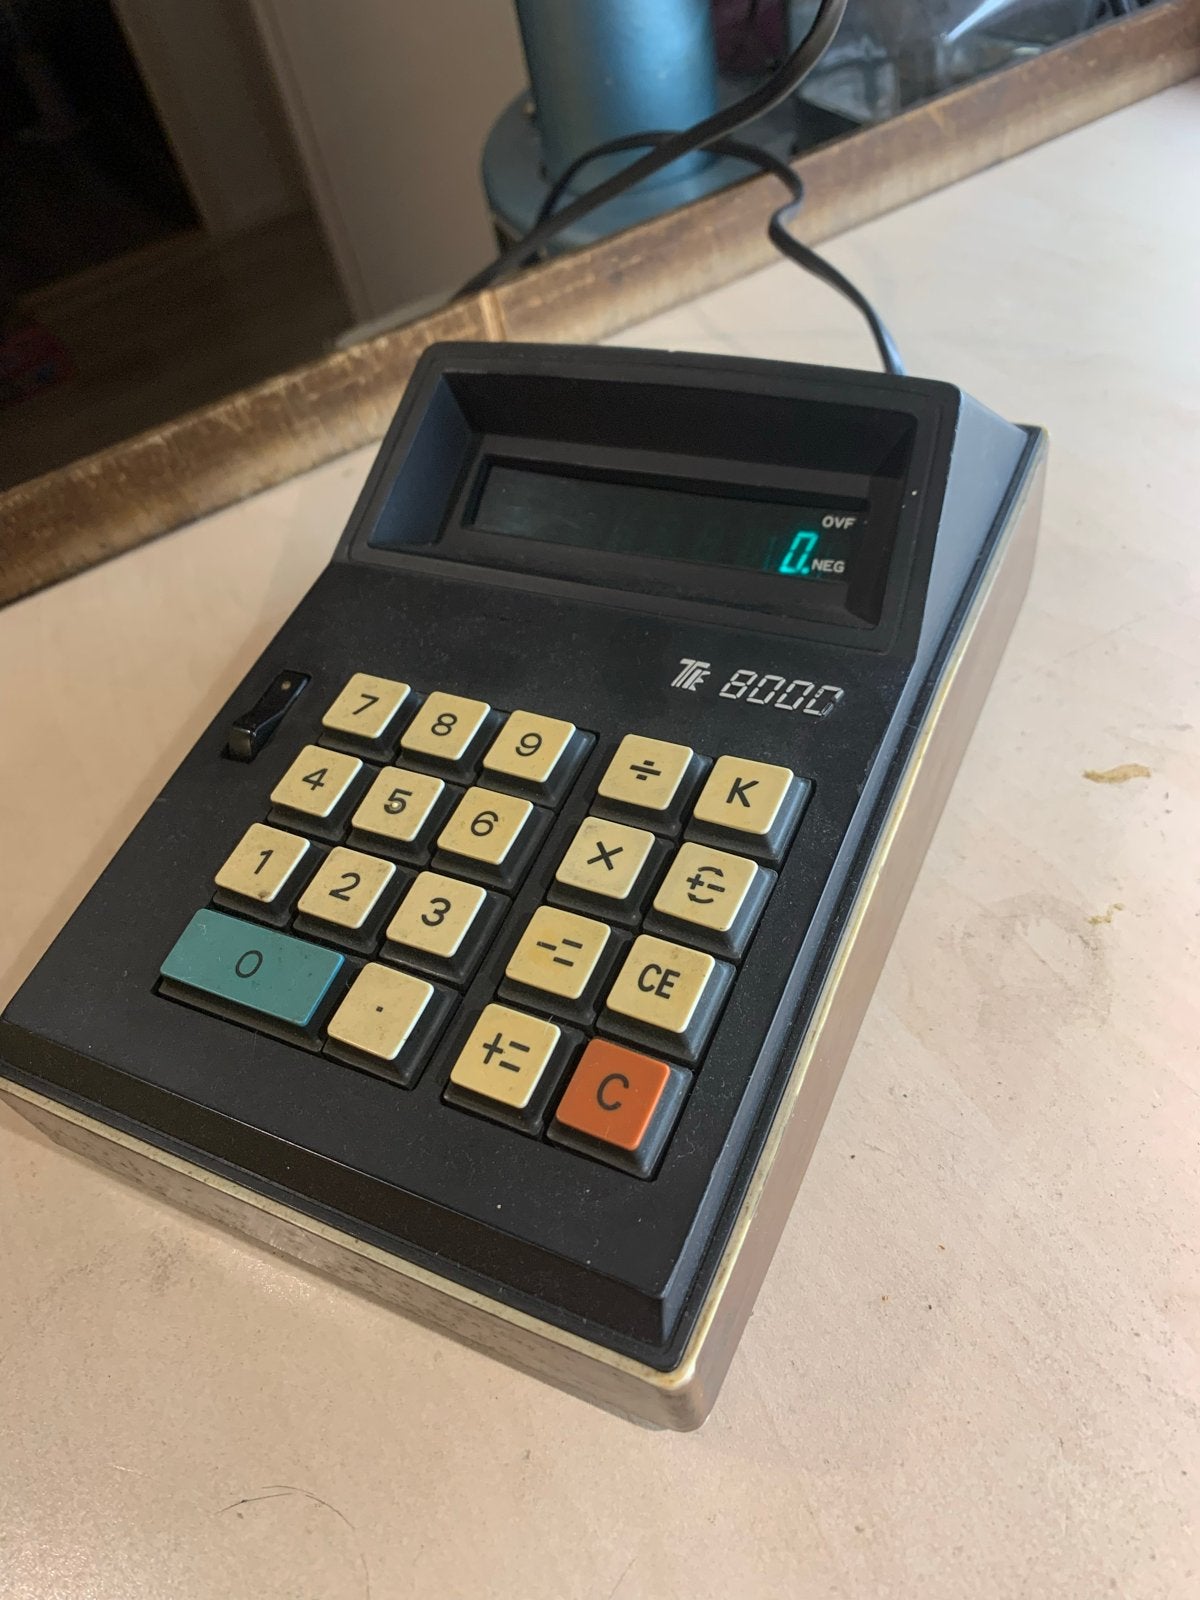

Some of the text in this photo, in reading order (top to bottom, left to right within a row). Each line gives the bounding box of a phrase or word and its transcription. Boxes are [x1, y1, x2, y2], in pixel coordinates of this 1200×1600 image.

[822, 515, 856, 530] OVF
[811, 558, 845, 573] NEG
[351, 693, 380, 716] 7
[719, 669, 844, 716] 8000
[430, 712, 458, 736] 8
[515, 732, 543, 757] 9
[301, 767, 329, 791] 4
[383, 789, 412, 815] 5
[725, 777, 760, 808] K
[470, 810, 499, 837] 6
[254, 849, 274, 875] 1
[328, 872, 362, 901] 2
[421, 897, 452, 926] 3
[637, 963, 681, 1000] CE
[596, 1073, 630, 1111] C
